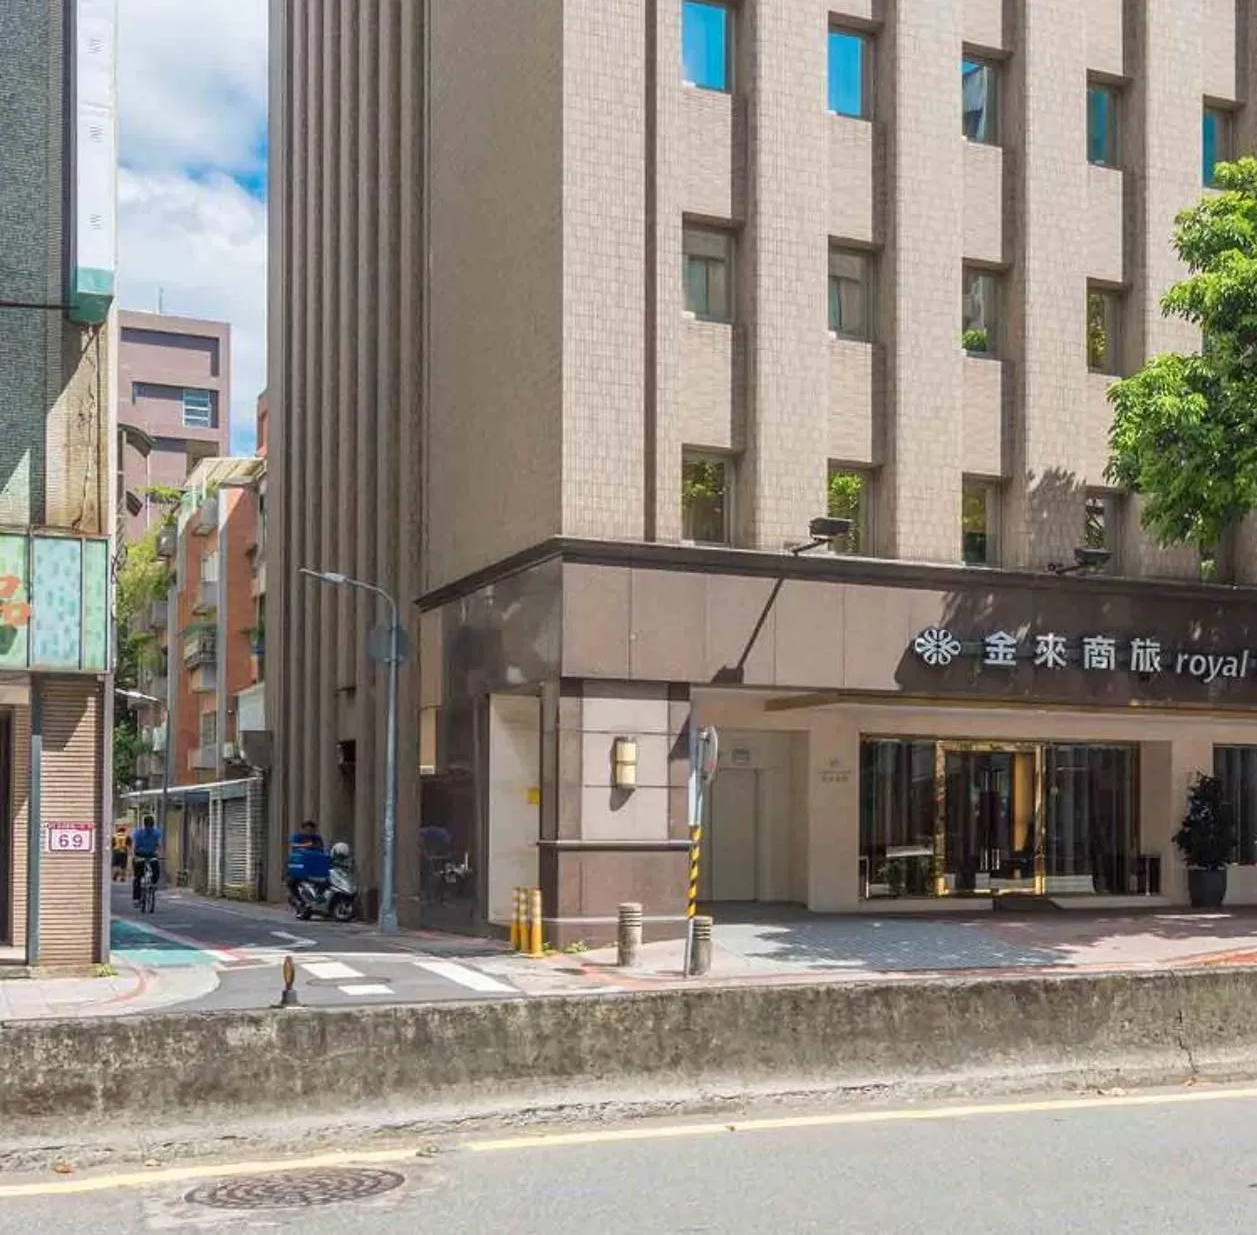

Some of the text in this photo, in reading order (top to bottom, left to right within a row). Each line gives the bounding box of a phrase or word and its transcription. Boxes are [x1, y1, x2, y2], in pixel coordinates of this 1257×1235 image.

[984, 631, 1162, 673] 金來商旅
[1175, 650, 1249, 683] royal
[59, 834, 83, 847] 69
